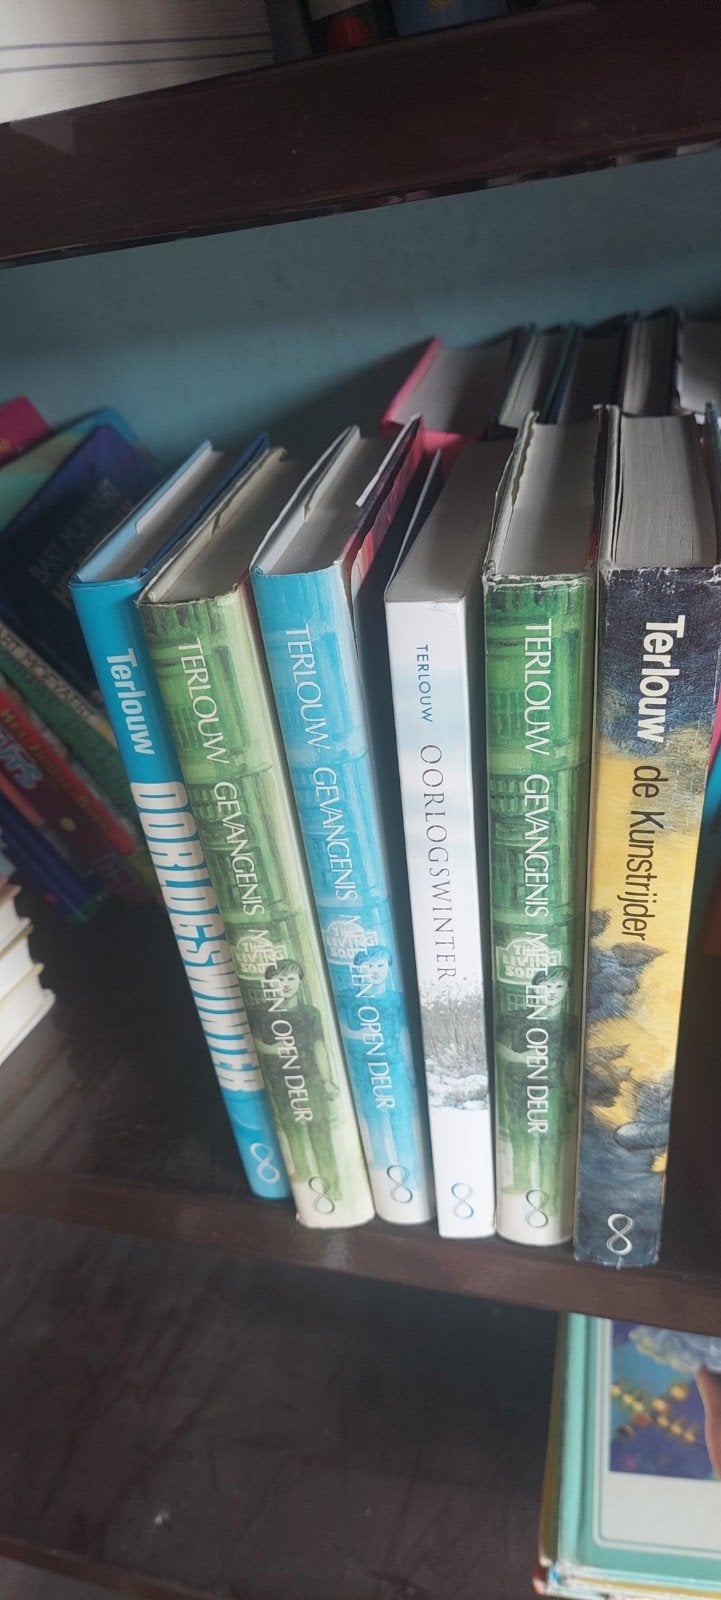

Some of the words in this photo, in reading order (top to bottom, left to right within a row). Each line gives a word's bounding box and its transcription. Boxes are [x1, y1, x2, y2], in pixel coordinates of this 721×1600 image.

[22, 654, 94, 719] MOEYAERT
[107, 648, 155, 754] Terlouw
[178, 637, 229, 763] TERLOUW
[285, 623, 330, 749] TERLOUW
[416, 644, 433, 722] TERLOUW
[524, 618, 552, 756] TERLOUW
[636, 615, 686, 743] Terlouw
[632, 764, 669, 799] de
[213, 781, 264, 916] GEVANGENIS
[313, 767, 358, 900] GEVANGENIS
[420, 744, 457, 981] OORLOGSWINTER
[524, 774, 551, 918] GEVANGENIS
[617, 809, 666, 942] Kunstrijder
[130, 781, 264, 1091] OORLOGSWINTER
[248, 929, 278, 970] MET
[525, 932, 550, 975] MET
[262, 977, 286, 1012] EEN
[350, 963, 374, 998] EEN
[525, 984, 549, 1021] EEN
[271, 1020, 301, 1068] OPEN
[357, 1006, 384, 1056] OPEN
[525, 1027, 550, 1078] OPEN
[284, 1075, 313, 1122] DEUR
[368, 1062, 395, 1109] DEUR
[526, 1084, 550, 1134] DEUR
